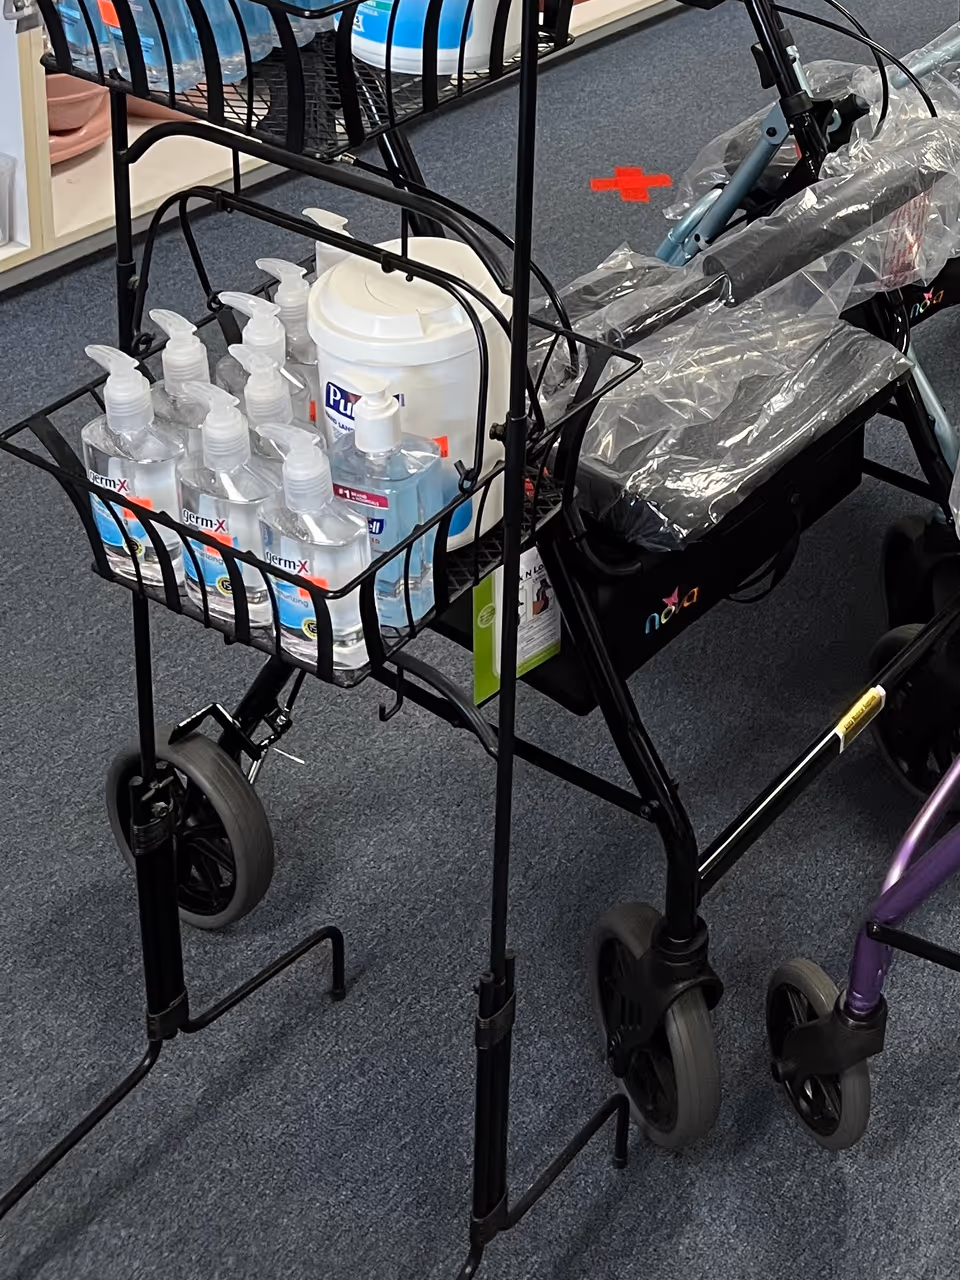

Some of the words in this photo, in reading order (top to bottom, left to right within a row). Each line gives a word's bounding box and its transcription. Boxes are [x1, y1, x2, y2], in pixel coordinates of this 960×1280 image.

[89, 470, 129, 492] germ-X
[338, 488, 350, 499] #1
[183, 509, 226, 532] germ-X
[266, 551, 309, 573] germ-X
